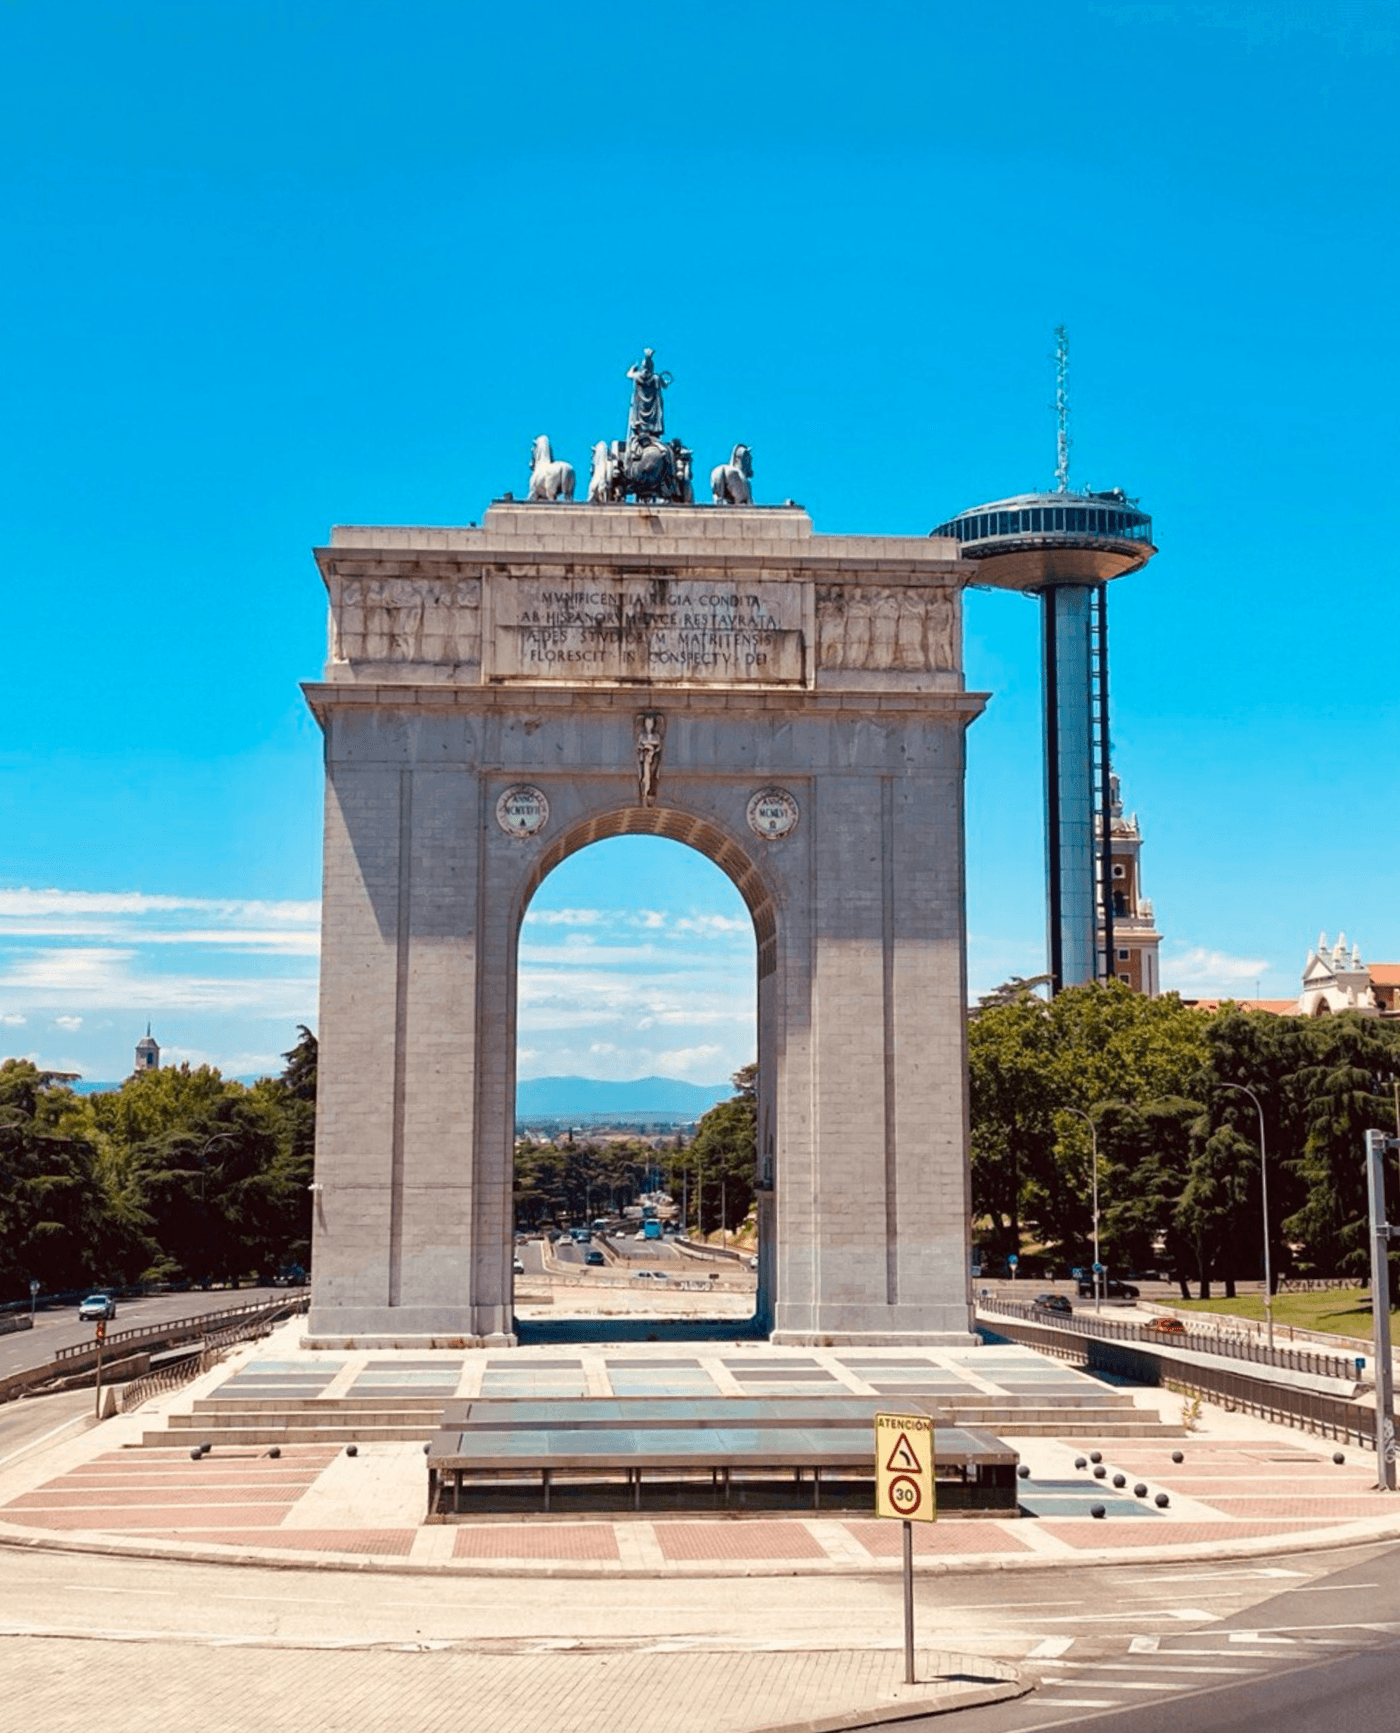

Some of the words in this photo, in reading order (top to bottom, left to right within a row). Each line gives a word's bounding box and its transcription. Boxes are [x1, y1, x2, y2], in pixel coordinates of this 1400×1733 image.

[542, 592, 645, 606] MVNIFICENTIA
[699, 594, 759, 607] CONDITA
[521, 611, 540, 622] AB
[684, 613, 777, 628] RESTAVRATA
[677, 633, 772, 646] MATRITENSIS
[530, 650, 606, 662] FLORESCIT
[623, 651, 635, 662] IN
[649, 651, 731, 665] CONSPECTV
[745, 653, 767, 665] DEI
[896, 1488, 913, 1502] 30
